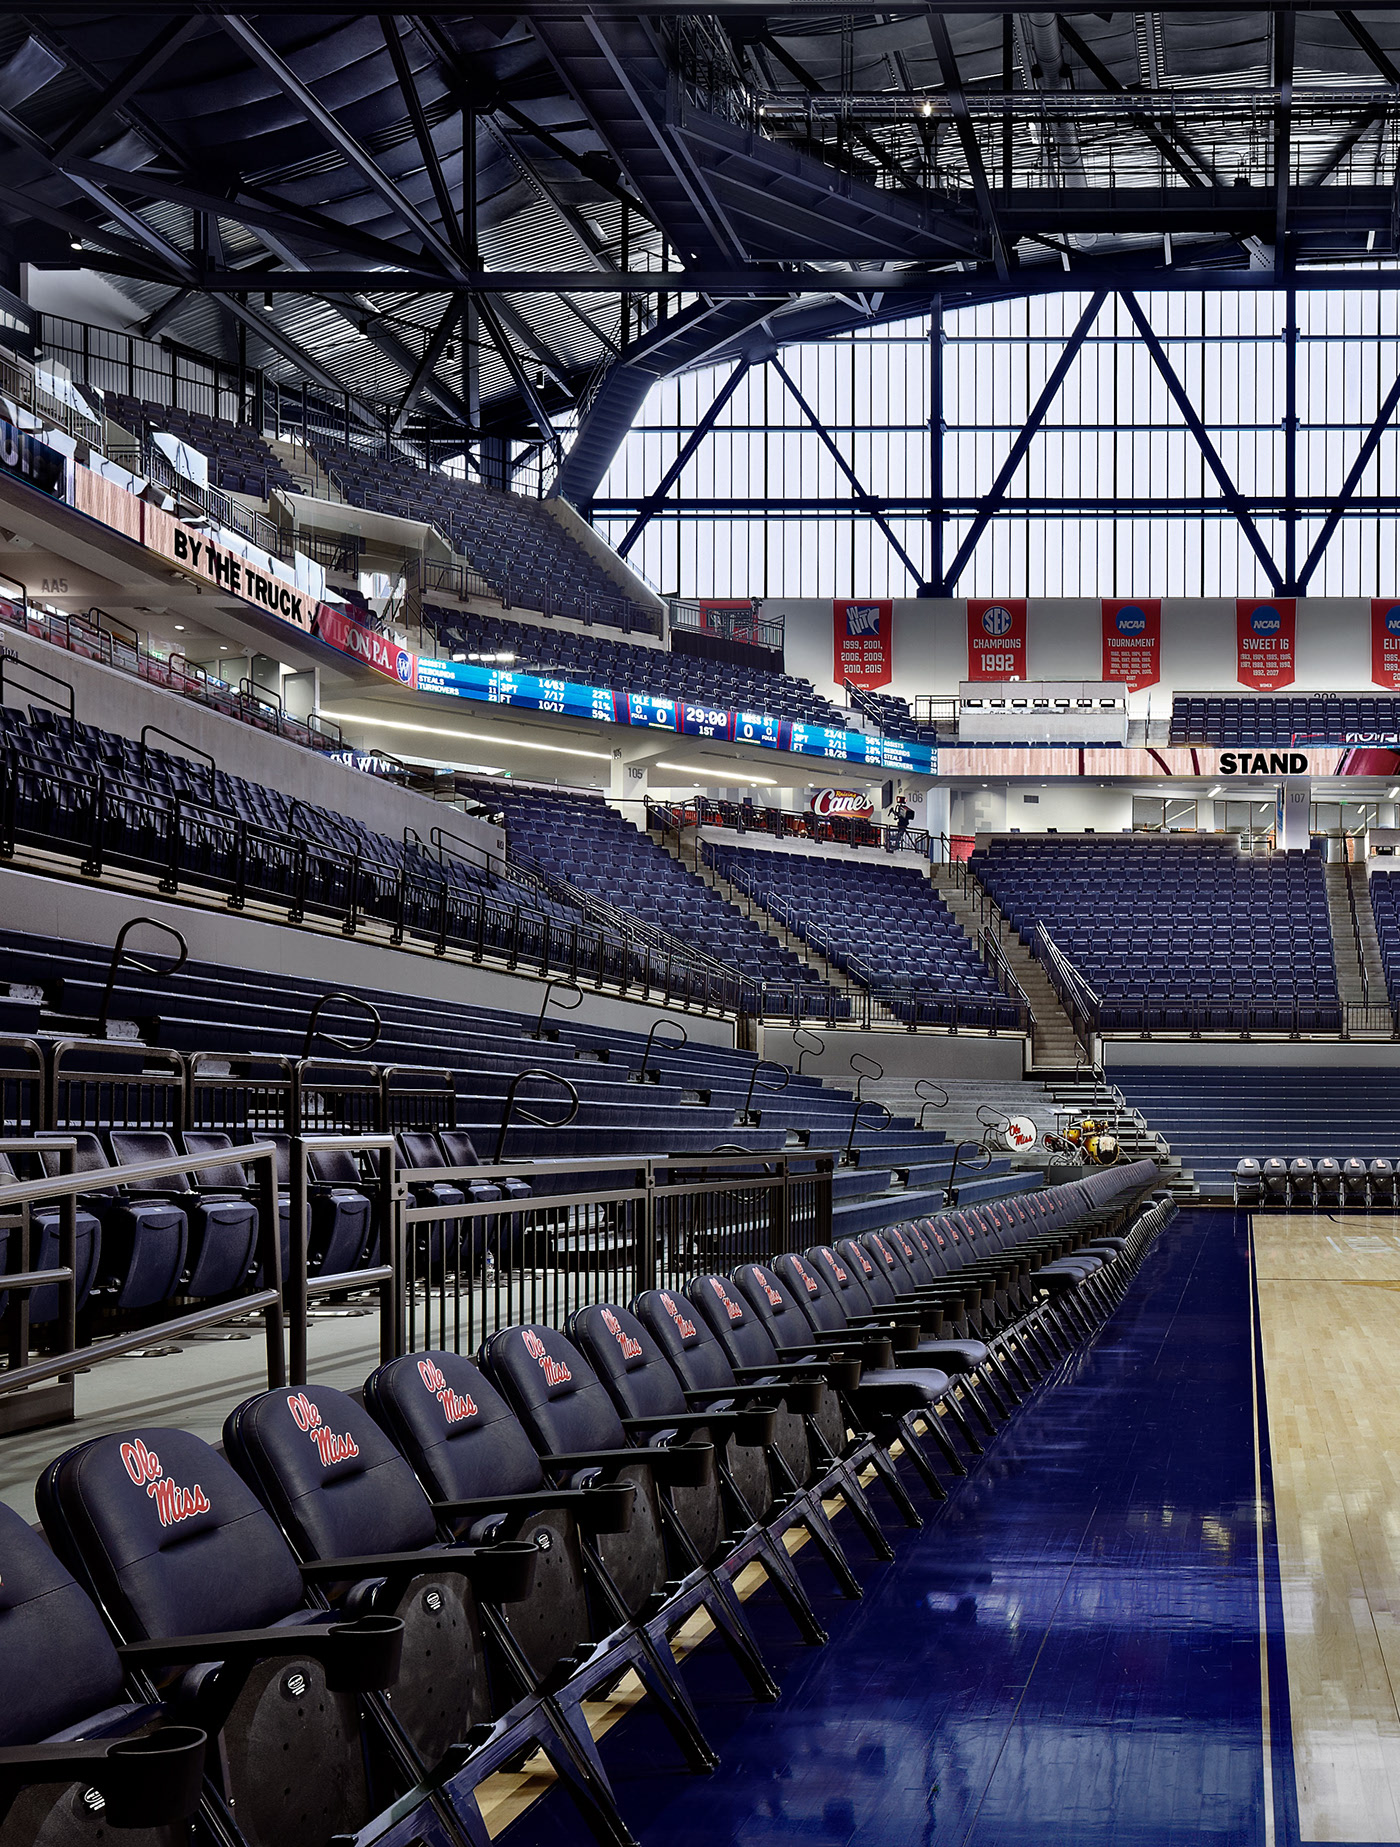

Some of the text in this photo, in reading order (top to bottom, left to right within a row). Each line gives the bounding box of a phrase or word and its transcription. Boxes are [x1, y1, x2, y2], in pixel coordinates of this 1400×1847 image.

[174, 528, 303, 624] BY THE TRUCK
[42, 578, 68, 593] AA5
[985, 608, 1010, 634] SEC
[1119, 620, 1145, 629] NCAA
[1254, 620, 1280, 629] NCAA
[843, 641, 882, 650] 1999, 2001,
[974, 639, 1021, 649] CHAMPIONS
[1108, 638, 1155, 647] TOURNAMENT
[1243, 639, 1288, 650] SWEET 16
[373, 639, 392, 670] P.A.
[864, 653, 885, 662] 2009,
[981, 654, 1014, 671] 1992
[844, 665, 882, 674] 2010, 2015
[418, 675, 444, 685] STEALS
[418, 682, 459, 695] TURNOVERS
[501, 683, 610, 710] 3PT 7/17 41%
[592, 690, 610, 700] 22%
[501, 694, 611, 722] FT 10/17 59%
[632, 694, 672, 710] OLE MISS
[656, 709, 666, 723] 0
[686, 708, 727, 726] 29:00
[742, 714, 761, 724] MISS
[699, 726, 714, 736] 1ST
[744, 724, 753, 737] 0
[824, 729, 846, 740] 23/41
[794, 734, 880, 754] 3PT 2/11 18%
[824, 748, 847, 759] 18/26
[865, 755, 880, 764] 69%
[1219, 753, 1308, 774] STAND
[628, 768, 643, 779] 105
[815, 788, 873, 816] Cane's
[908, 792, 922, 804] 106
[1291, 793, 1305, 803] 107
[1010, 1124, 1020, 1136] Ole
[1014, 1134, 1033, 1146] Miss
[660, 1292, 677, 1316] Ole
[600, 1308, 622, 1336] Ole
[674, 1314, 696, 1339] Miss
[522, 1329, 546, 1359] Ole
[616, 1332, 642, 1360] Miss
[418, 1358, 446, 1393] Ole
[539, 1356, 572, 1386] Miss
[288, 1392, 322, 1432] Ole
[437, 1388, 478, 1424] Miss
[310, 1426, 358, 1467] Miss
[120, 1438, 162, 1485] Ole
[147, 1478, 210, 1526] Miss
